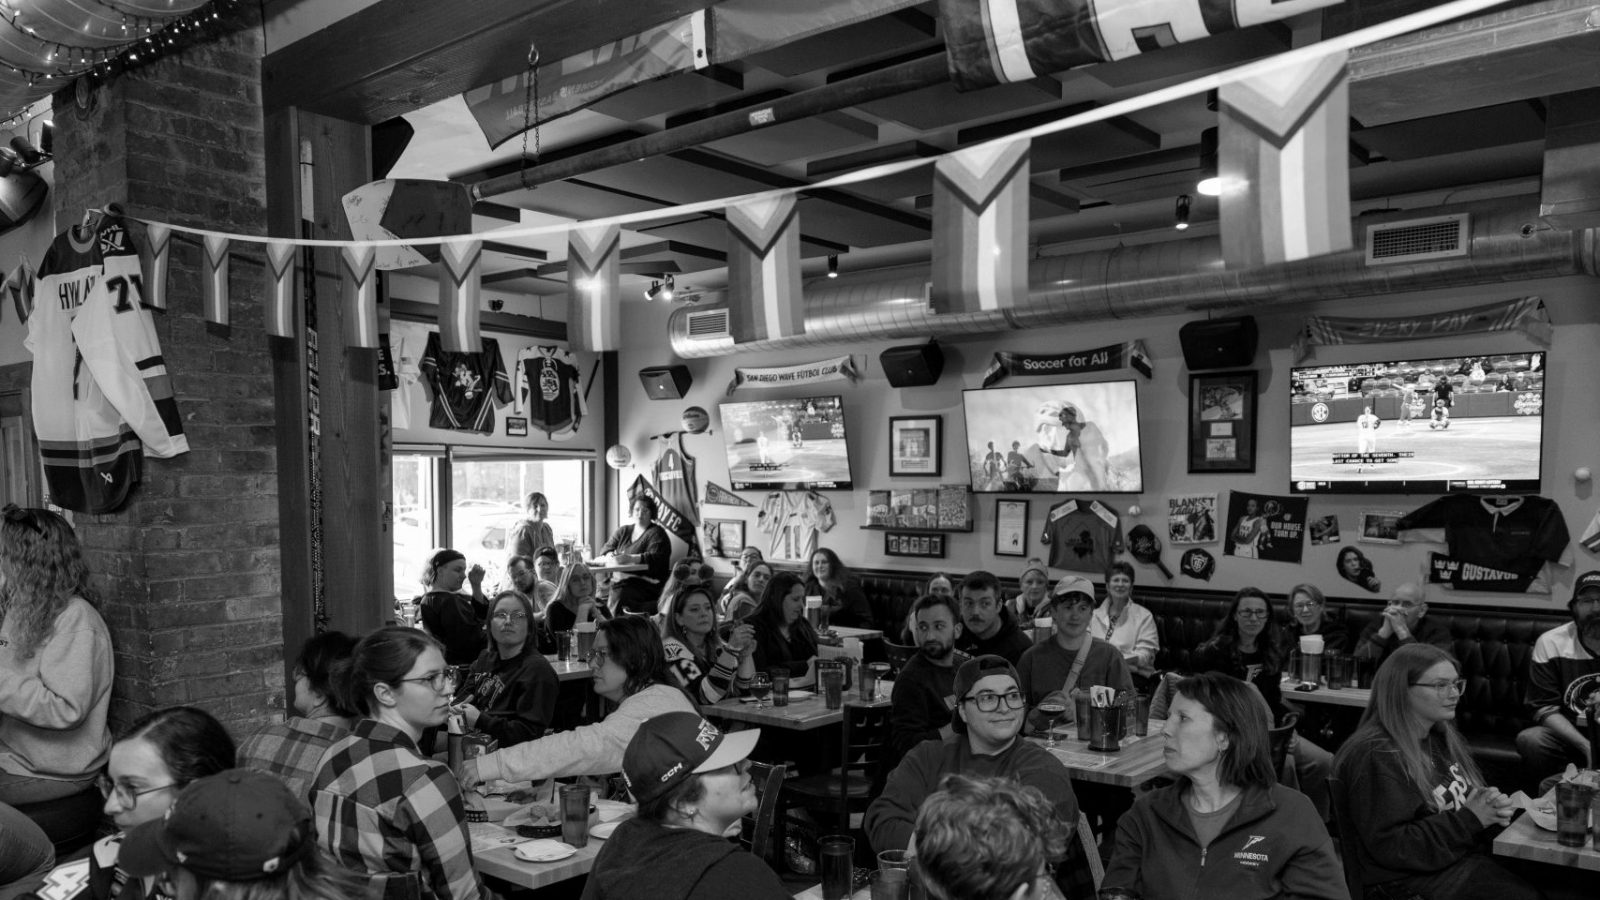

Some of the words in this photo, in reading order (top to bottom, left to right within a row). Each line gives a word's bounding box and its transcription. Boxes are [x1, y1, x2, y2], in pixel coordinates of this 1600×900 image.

[1023, 358, 1066, 370] Soccer
[1068, 355, 1088, 368] for
[1090, 351, 1109, 366] All
[746, 374, 758, 382] SAN
[759, 373, 777, 382] DIEGO
[779, 372, 795, 381] WAVE
[661, 762, 683, 783] CCM
[1233, 851, 1269, 862] MINNESOTA
